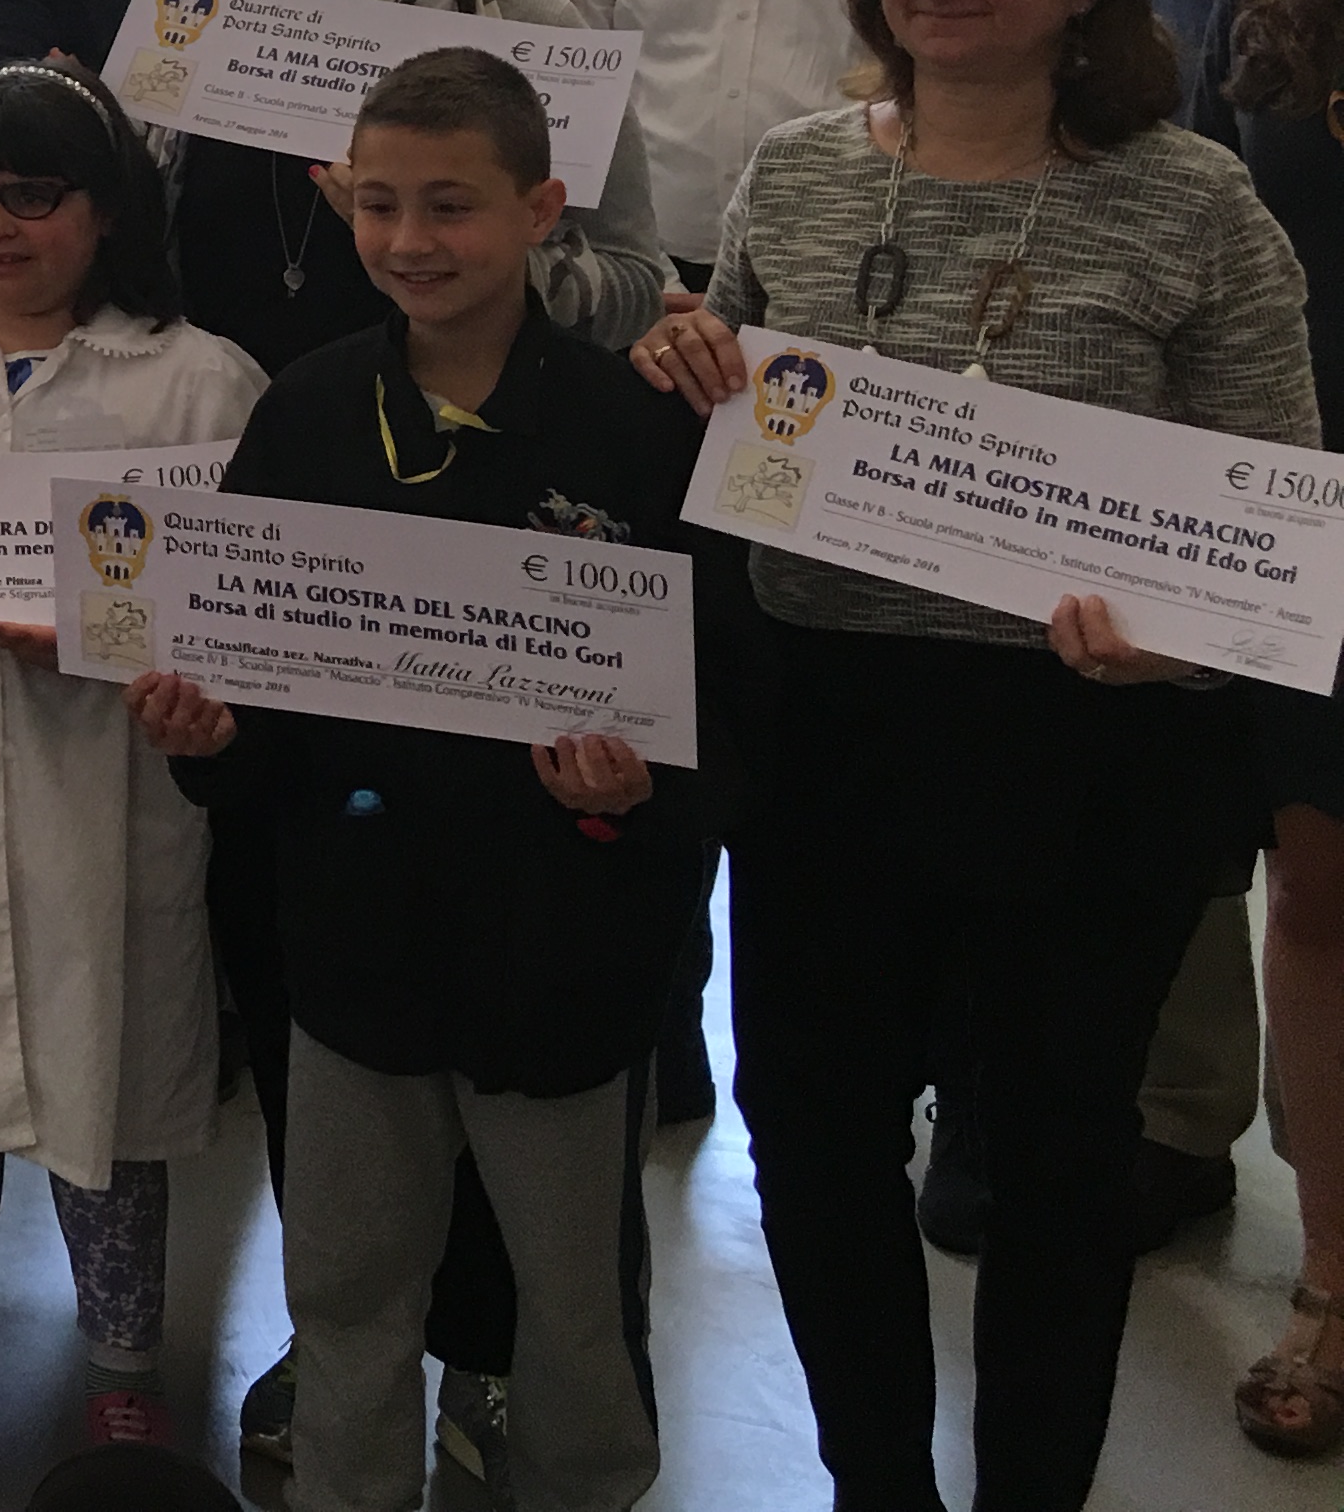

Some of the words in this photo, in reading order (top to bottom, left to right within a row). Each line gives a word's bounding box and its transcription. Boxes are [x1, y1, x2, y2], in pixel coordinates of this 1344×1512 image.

[222, 15, 267, 34] Porta
[271, 23, 319, 42] Santo
[322, 32, 381, 53] Spirito
[306, 10, 323, 24] di
[256, 45, 278, 61] LA
[284, 50, 319, 68] MIA
[510, 41, 535, 62] €
[544, 45, 622, 71] 150,00
[227, 59, 274, 79] Borsa
[279, 69, 298, 83] di
[301, 75, 356, 93] studio
[849, 376, 949, 414] Quartiere
[954, 401, 977, 421] di
[842, 399, 902, 428] Porta
[907, 416, 973, 445] Santo
[978, 433, 1057, 466] Spirito
[157, 461, 224, 488] 100,0
[1225, 462, 1255, 490] €
[890, 443, 920, 467] LA
[928, 454, 976, 482] MIA
[986, 469, 1090, 511] GIOSTRA
[1099, 496, 1142, 523] DEL
[1150, 509, 1275, 552] SARACINO
[164, 512, 255, 538] Quartiere
[262, 523, 281, 541] di
[852, 459, 916, 491] Borsa
[924, 479, 948, 498] di
[953, 490, 1028, 519] studio
[1035, 506, 1058, 528] in
[1066, 519, 1169, 555] memoria
[1176, 542, 1201, 562] di
[1206, 548, 1247, 573] Edo
[1254, 559, 1298, 584] Gori
[163, 536, 218, 558] Porta
[225, 543, 285, 566] Santo
[291, 551, 364, 575] Spirito
[521, 554, 549, 582] €
[564, 560, 668, 600] 100,00
[217, 573, 245, 593] LA
[253, 578, 298, 600] MIA
[306, 585, 406, 613] GIOSTRA
[414, 597, 455, 619] DEL
[463, 604, 591, 639] SARACINO
[189, 593, 248, 617] Borsa
[254, 603, 275, 621] di
[282, 608, 352, 629] studio
[360, 615, 380, 633] in
[389, 623, 488, 648] memoria
[495, 634, 517, 652] di
[525, 637, 568, 660] Edo
[575, 646, 622, 669] Gori
[172, 634, 184, 644] al
[204, 637, 279, 657] Classificato
[282, 650, 309, 661] sez.
[313, 650, 374, 669] Narrativa
